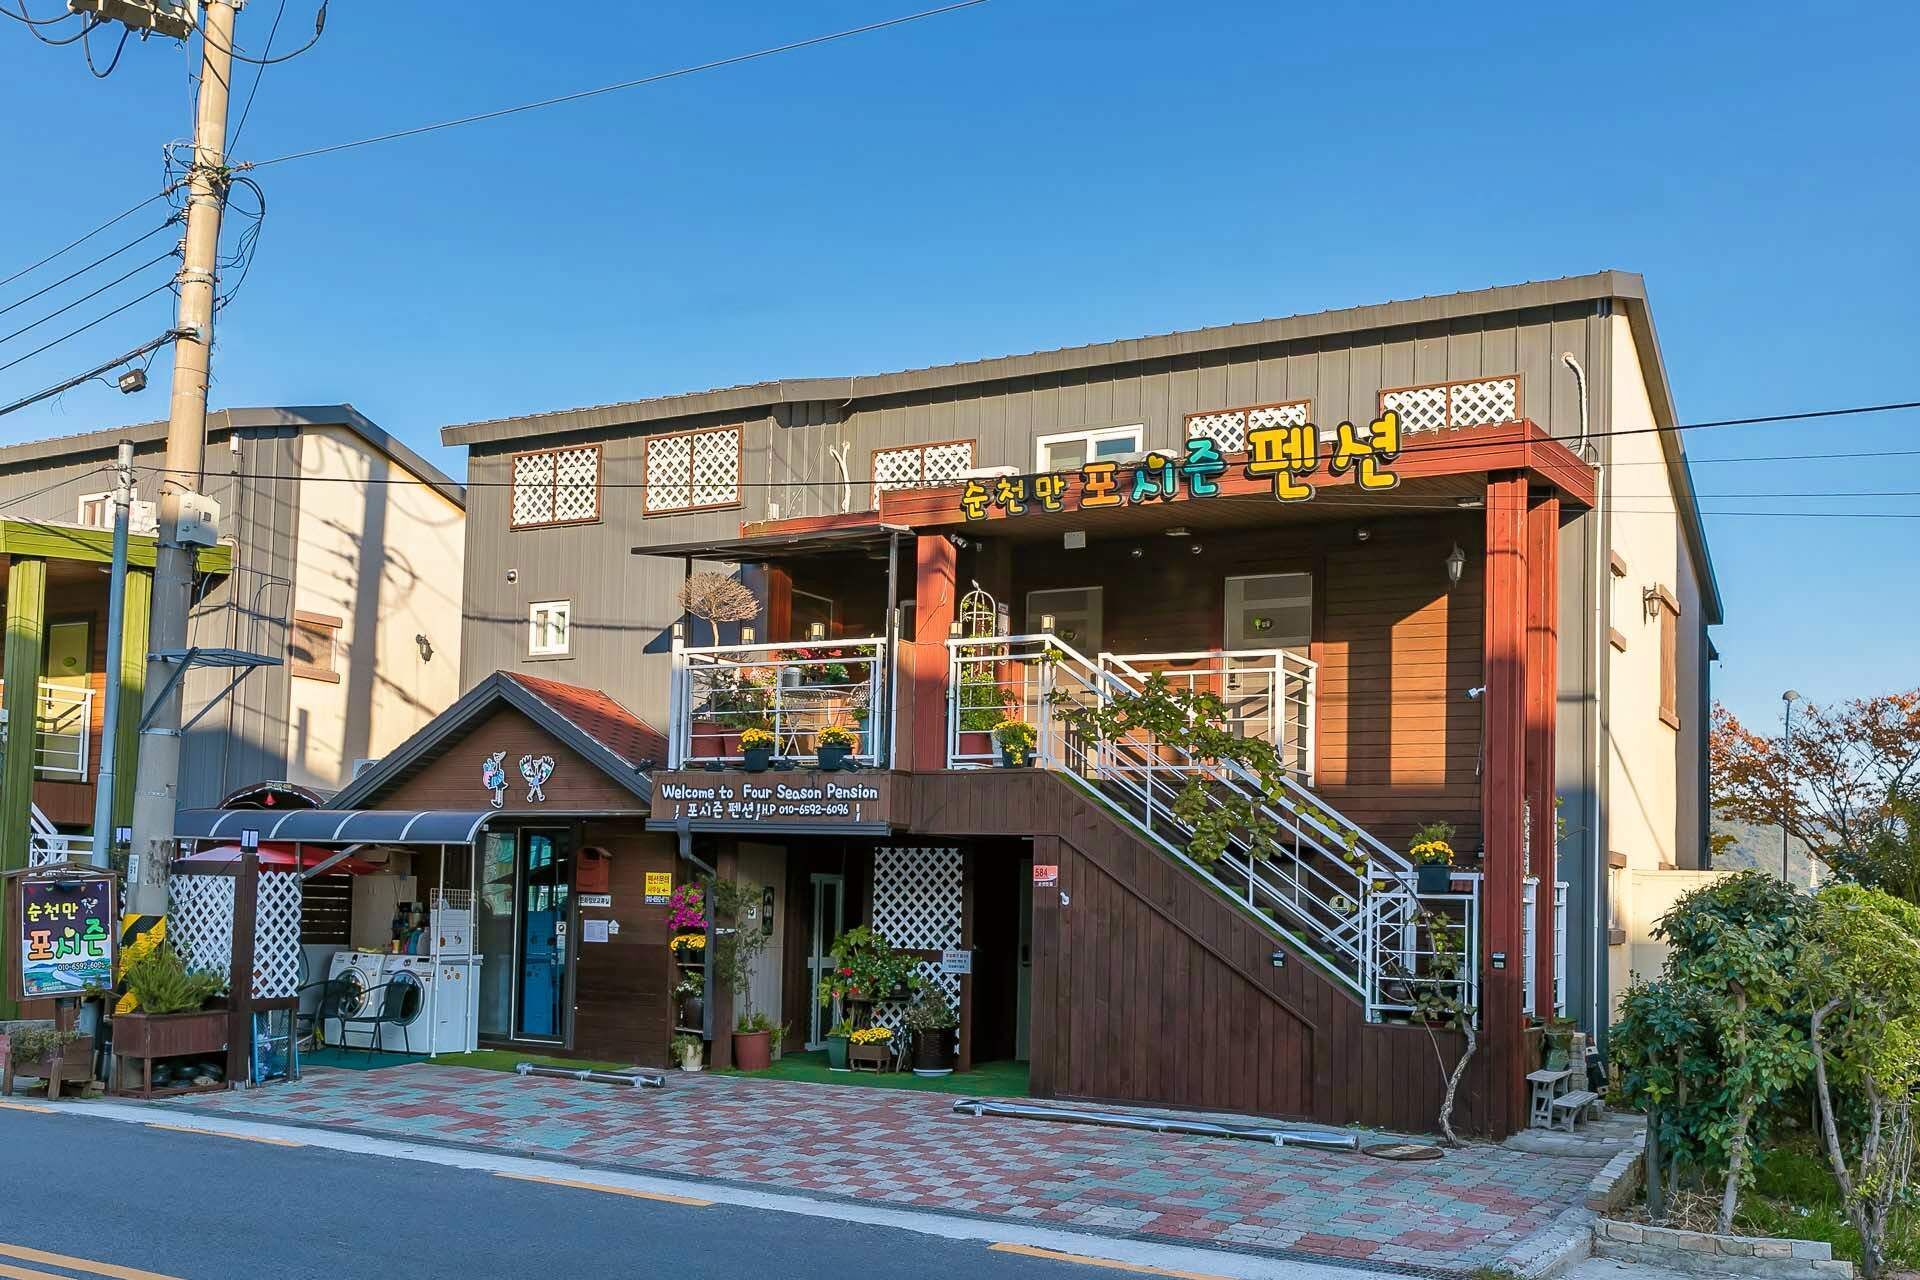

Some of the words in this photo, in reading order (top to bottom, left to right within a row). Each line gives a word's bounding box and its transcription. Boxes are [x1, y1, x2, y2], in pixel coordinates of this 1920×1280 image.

[961, 474, 1065, 520] 순천만
[1081, 438, 1227, 509] 포시즌
[1246, 410, 1402, 503] 펜션
[661, 784, 715, 799] Welcome
[719, 785, 734, 799] to
[743, 784, 773, 799] Four
[776, 784, 822, 800] Season
[827, 783, 878, 799] Pension
[687, 801, 723, 819] 포시즌
[778, 803, 849, 815] 010-6592-6096
[1034, 867, 1049, 878] 584
[27, 902, 79, 922] 순천만
[28, 917, 107, 960] 포시즌
